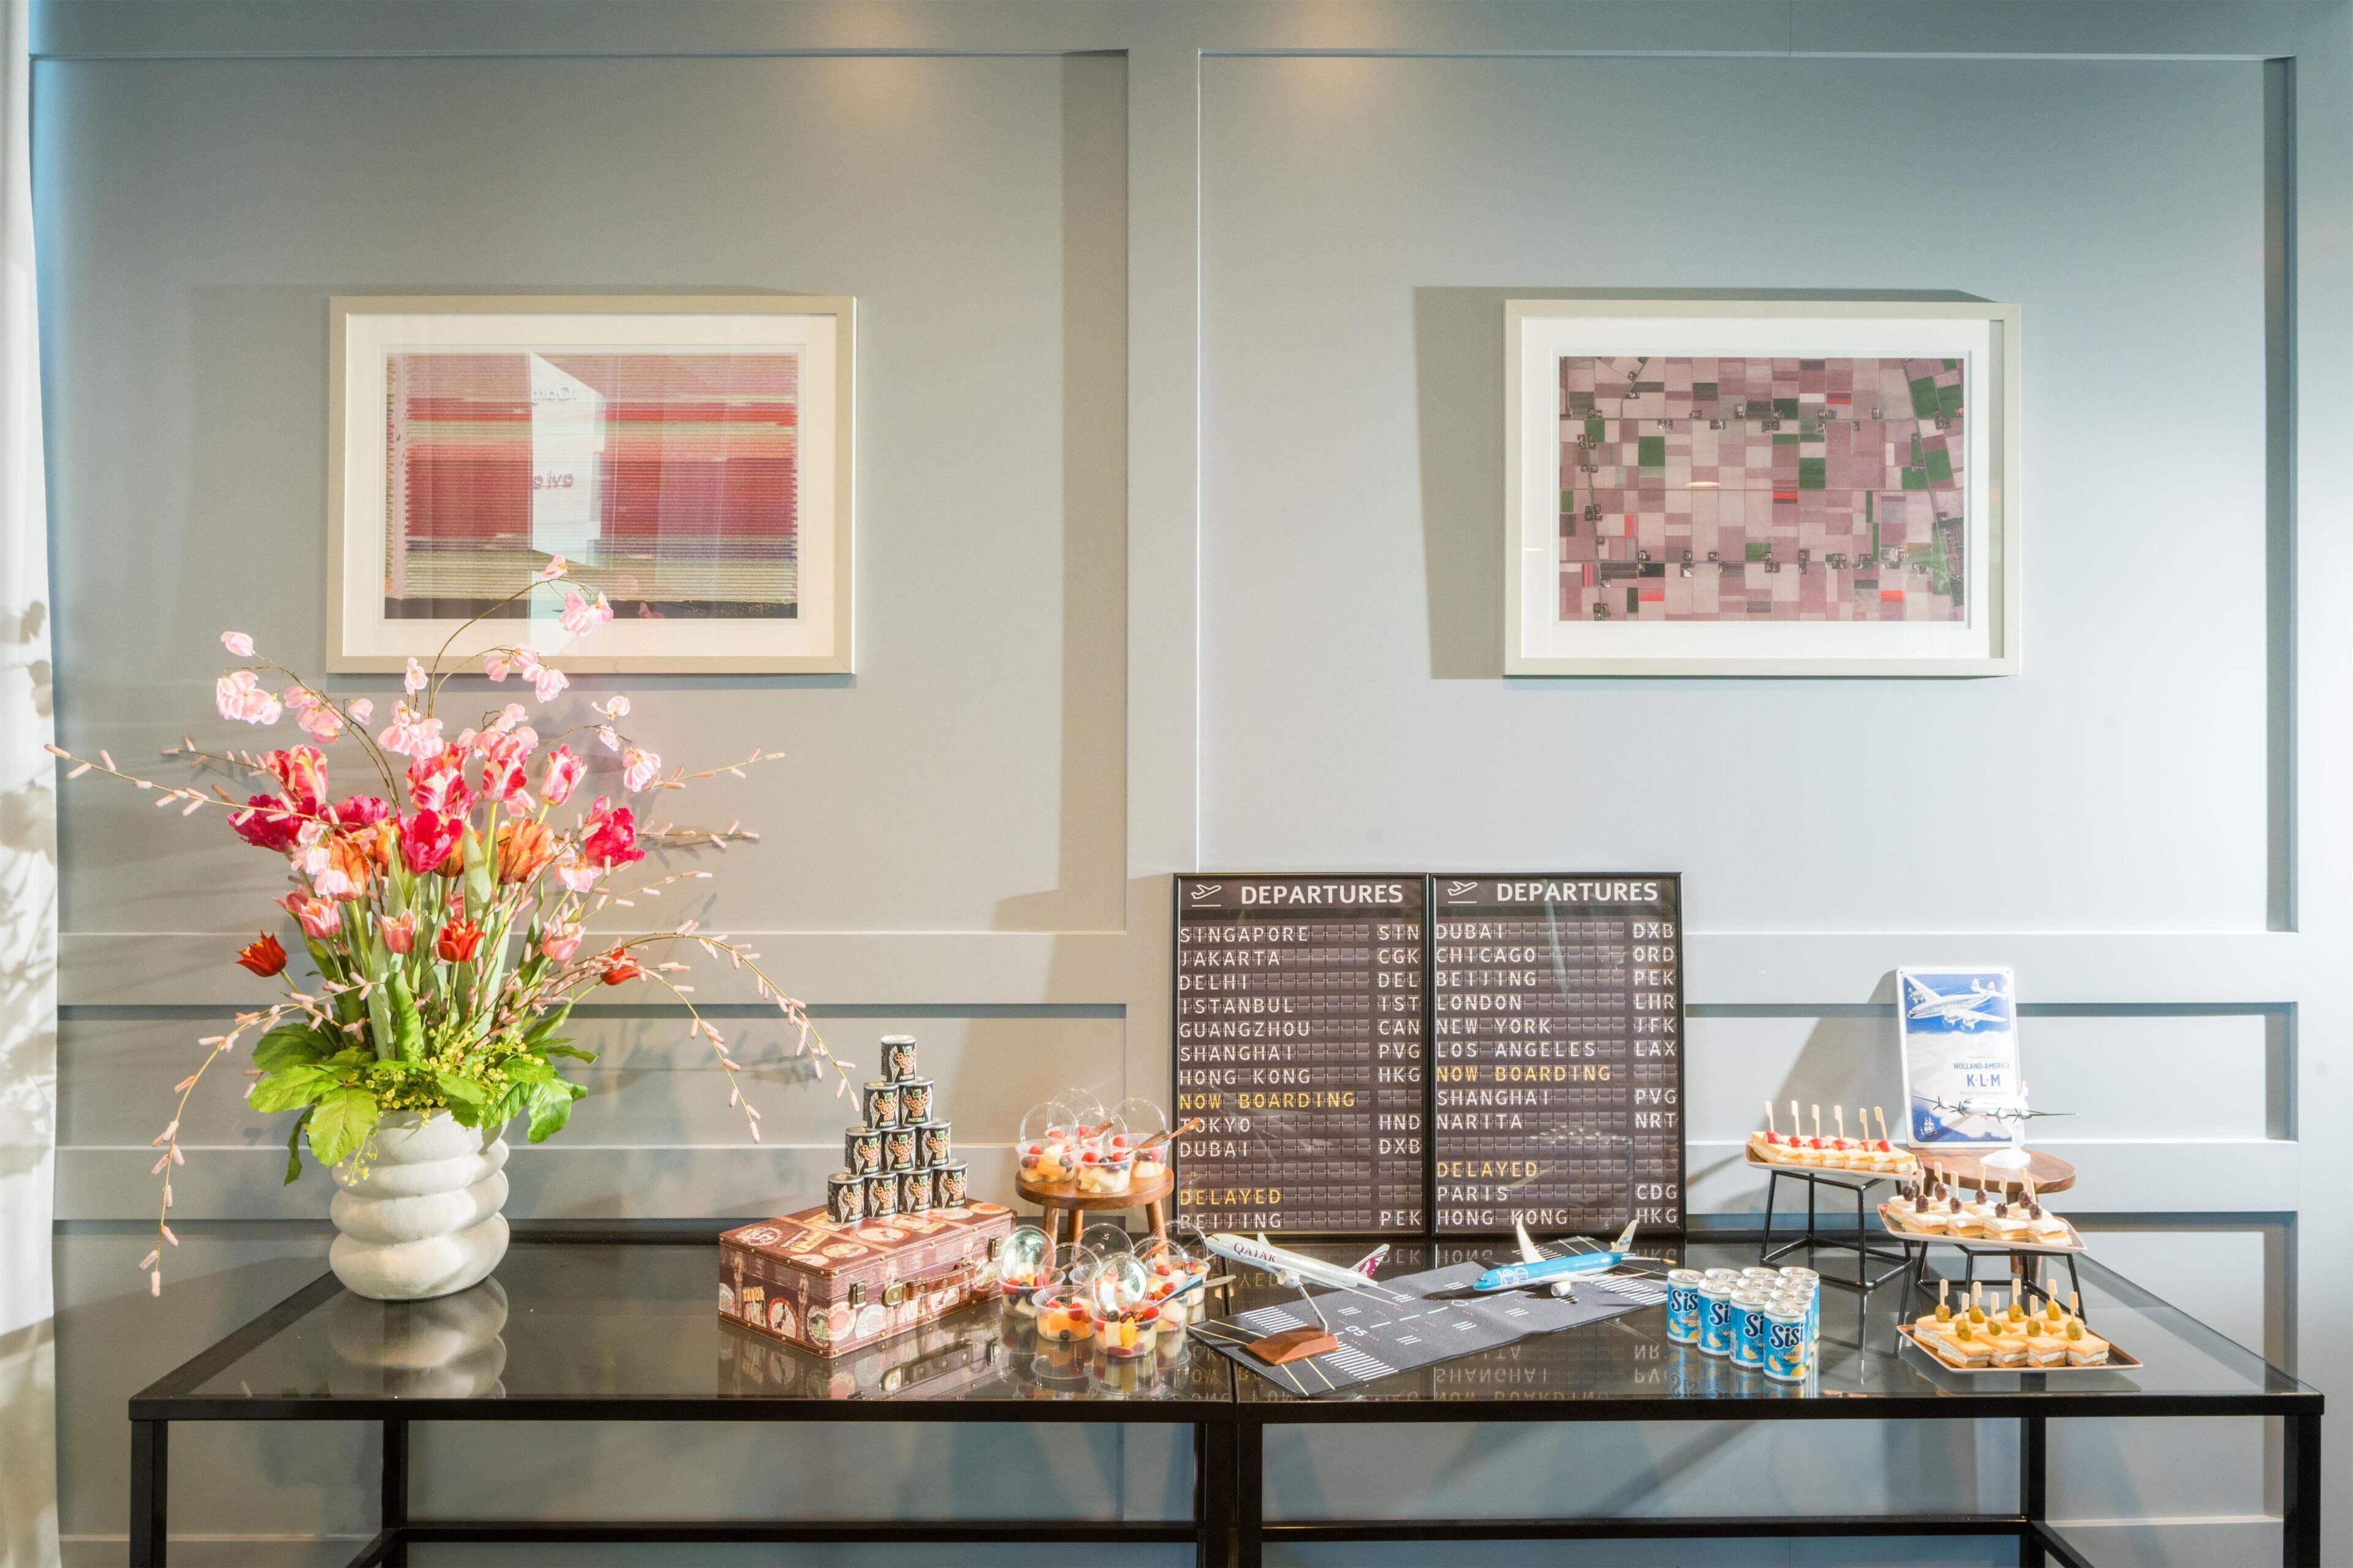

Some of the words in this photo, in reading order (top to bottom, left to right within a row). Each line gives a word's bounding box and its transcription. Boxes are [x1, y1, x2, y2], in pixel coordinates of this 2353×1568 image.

[1241, 884, 1403, 904] DEPARTURES
[1497, 882, 1658, 901] DEPARTURES
[1180, 926, 1308, 942] SINGAPORE
[1379, 926, 1419, 941] SIN
[1436, 924, 1502, 939] DUBAI
[1634, 923, 1674, 939] DXB
[1182, 951, 1280, 966] JAKARTA
[1378, 949, 1419, 964] CGK
[1436, 947, 1536, 963] CHICAGO
[1634, 947, 1674, 962] ORD
[1180, 975, 1246, 990] DELHI
[1378, 973, 1418, 988] DEL
[1436, 971, 1536, 987] BEIJING
[1634, 971, 1674, 986] PEK
[1183, 999, 1294, 1014] ISTANBUL
[1382, 996, 1419, 1012] IST
[1437, 995, 1521, 1010] LONDON
[1635, 994, 1674, 1010] LHR
[1180, 1022, 1310, 1038] GUANGZHOU
[1378, 1020, 1420, 1036] CAN
[1437, 1019, 1477, 1034] NEW
[1495, 1018, 1551, 1034] YORK
[1637, 1018, 1675, 1033] JFK
[1180, 1046, 1291, 1062] SHANGHAI
[1379, 1043, 1420, 1059] PVG
[1438, 1042, 1477, 1058] LOS
[1495, 1042, 1595, 1058] ANGELES
[1635, 1042, 1676, 1056] LAX
[1180, 1070, 1237, 1086] HONG
[1254, 1069, 1311, 1085] KONG
[1379, 1067, 1420, 1083] HKG
[1437, 1066, 1478, 1081] NOW
[1495, 1065, 1611, 1081] BOARDING
[1180, 1094, 1222, 1110] NOW
[1239, 1092, 1355, 1109] BOARDING
[1438, 1090, 1548, 1106] SHANGHAI
[1635, 1089, 1677, 1105] PVG
[1379, 1115, 1420, 1131] HND
[1437, 1113, 1523, 1129] NARITA
[1635, 1113, 1676, 1128] NRT
[1180, 1142, 1248, 1157] DUBAI
[1379, 1139, 1421, 1154] DXB
[1438, 1162, 1537, 1177] DELAYED
[1180, 1189, 1281, 1205] DELAYED
[1438, 1186, 1508, 1202] PARIS
[1636, 1185, 1677, 1200] CDG
[1180, 1213, 1281, 1229] BEIJING
[1380, 1211, 1421, 1226] PEK
[1438, 1210, 1493, 1225] HONG
[1511, 1210, 1567, 1225] KONG
[1636, 1208, 1677, 1224] HKG
[1671, 1290, 1698, 1312] Sis
[1709, 1303, 1730, 1325] Si
[1745, 1314, 1765, 1338] Si
[1770, 1322, 1804, 1348] Sisi
